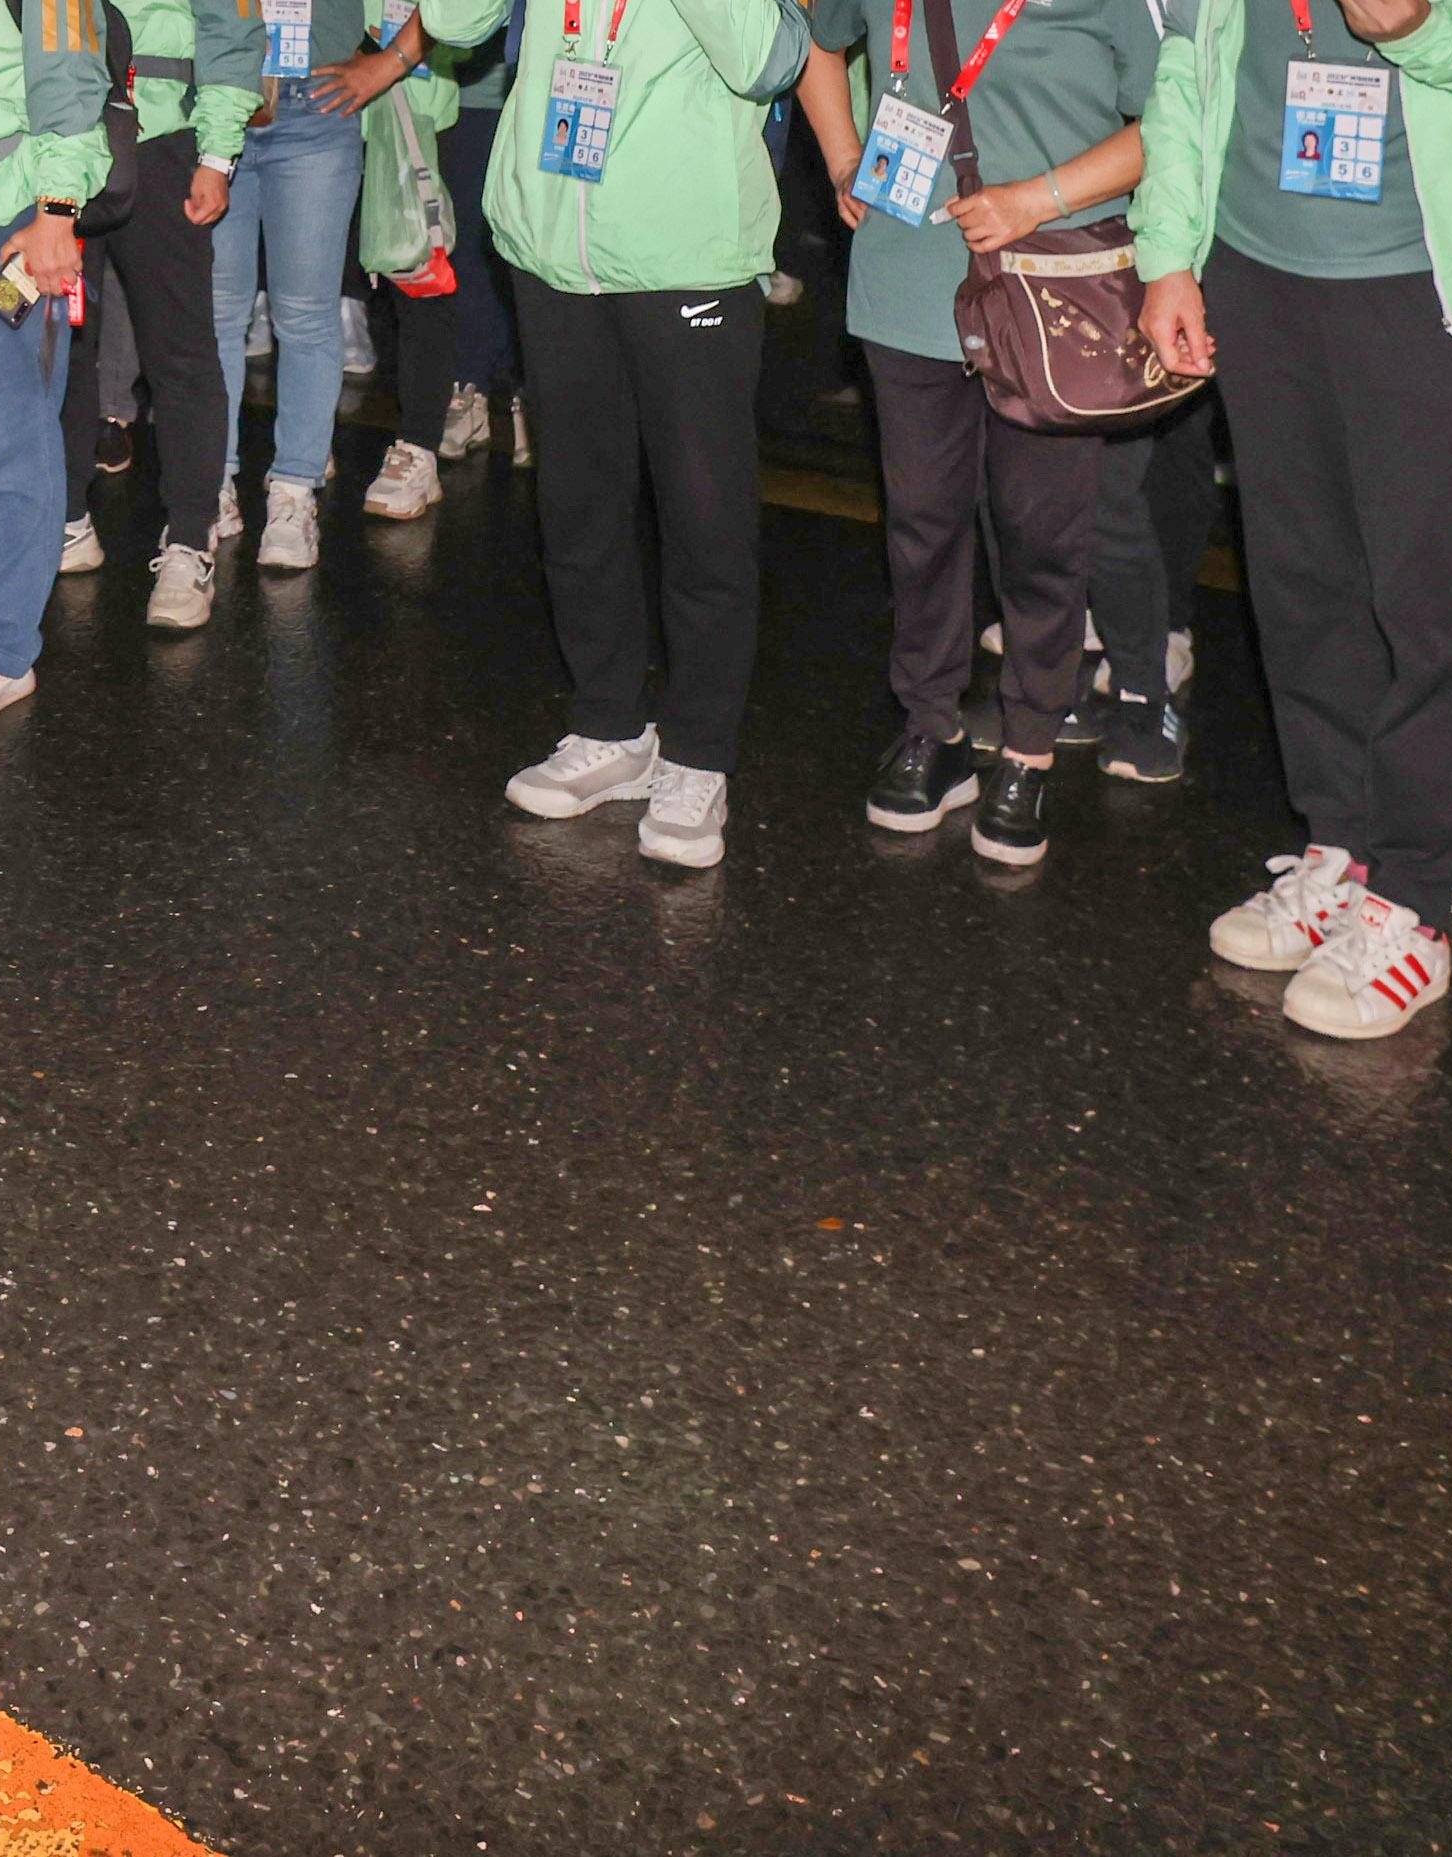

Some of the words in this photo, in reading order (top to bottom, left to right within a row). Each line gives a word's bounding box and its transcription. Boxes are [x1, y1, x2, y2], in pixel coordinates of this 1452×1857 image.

[1340, 141, 1349, 152] 3
[1338, 165, 1347, 175] 5
[1362, 167, 1372, 178] 6
